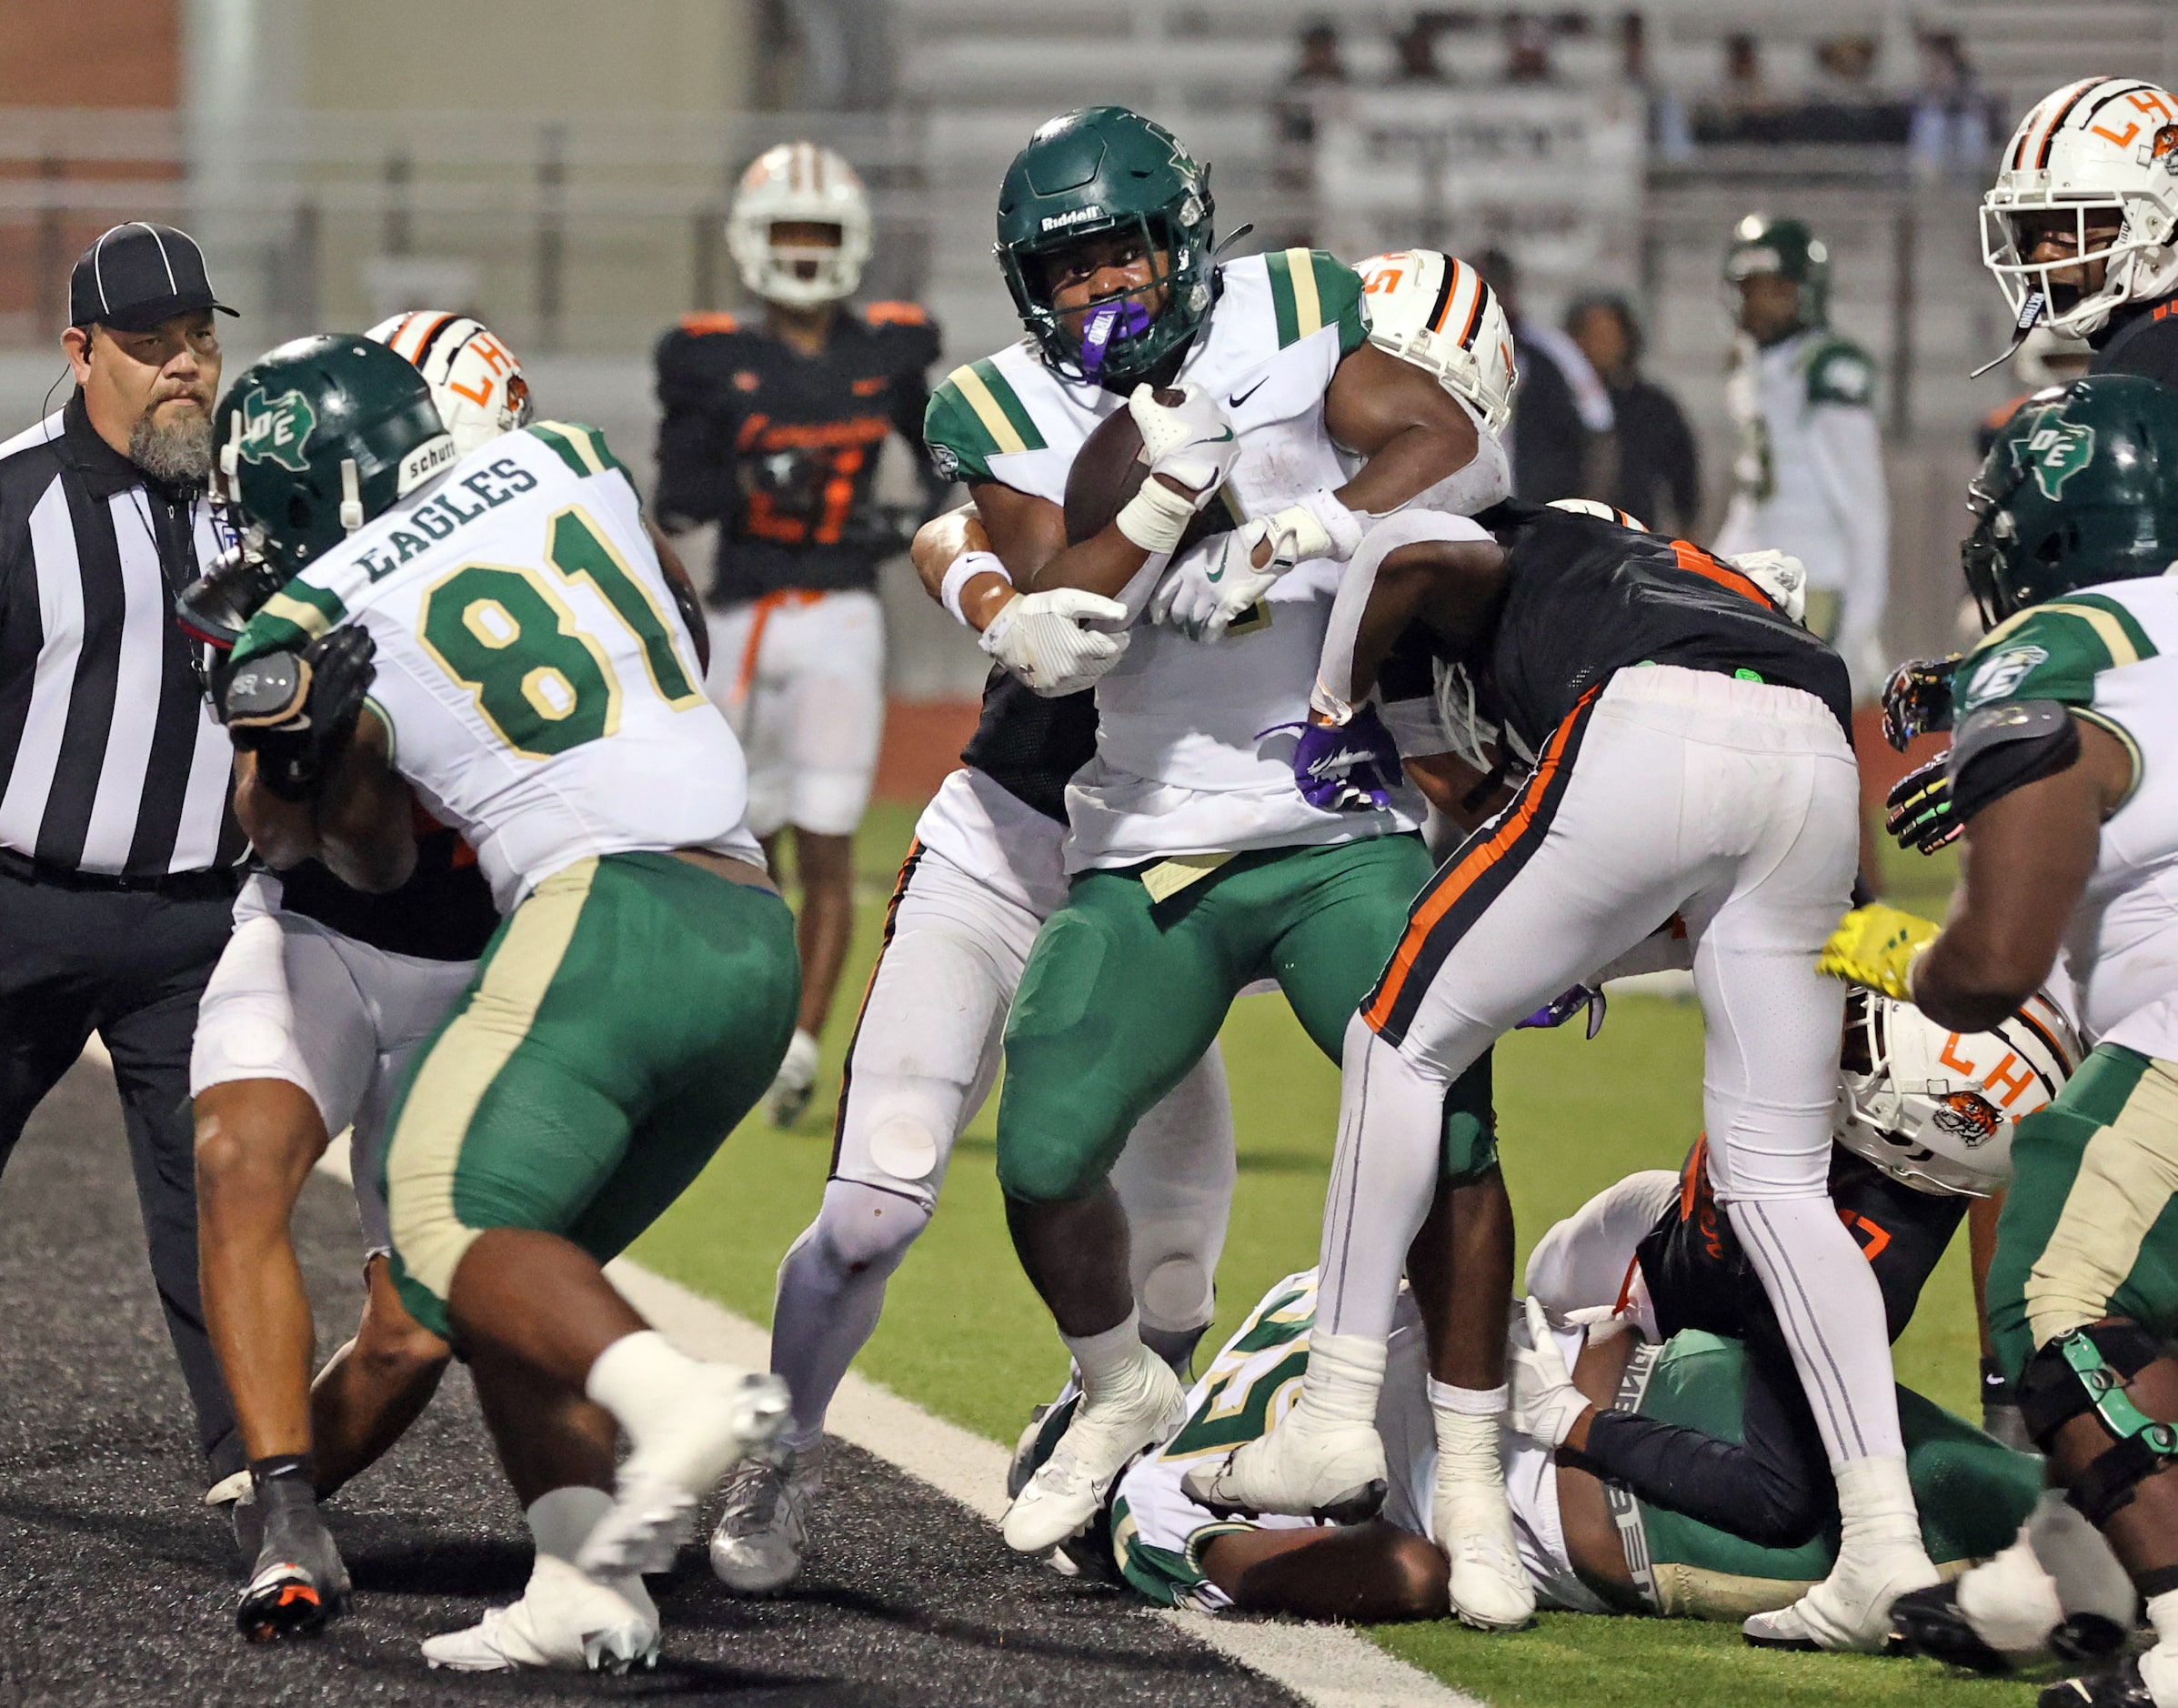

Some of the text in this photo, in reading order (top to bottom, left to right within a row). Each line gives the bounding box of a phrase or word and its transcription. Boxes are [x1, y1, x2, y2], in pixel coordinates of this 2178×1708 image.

[1042, 206, 1100, 232] Riddell
[352, 457, 538, 585] EAGLES
[415, 502, 708, 762] 81
